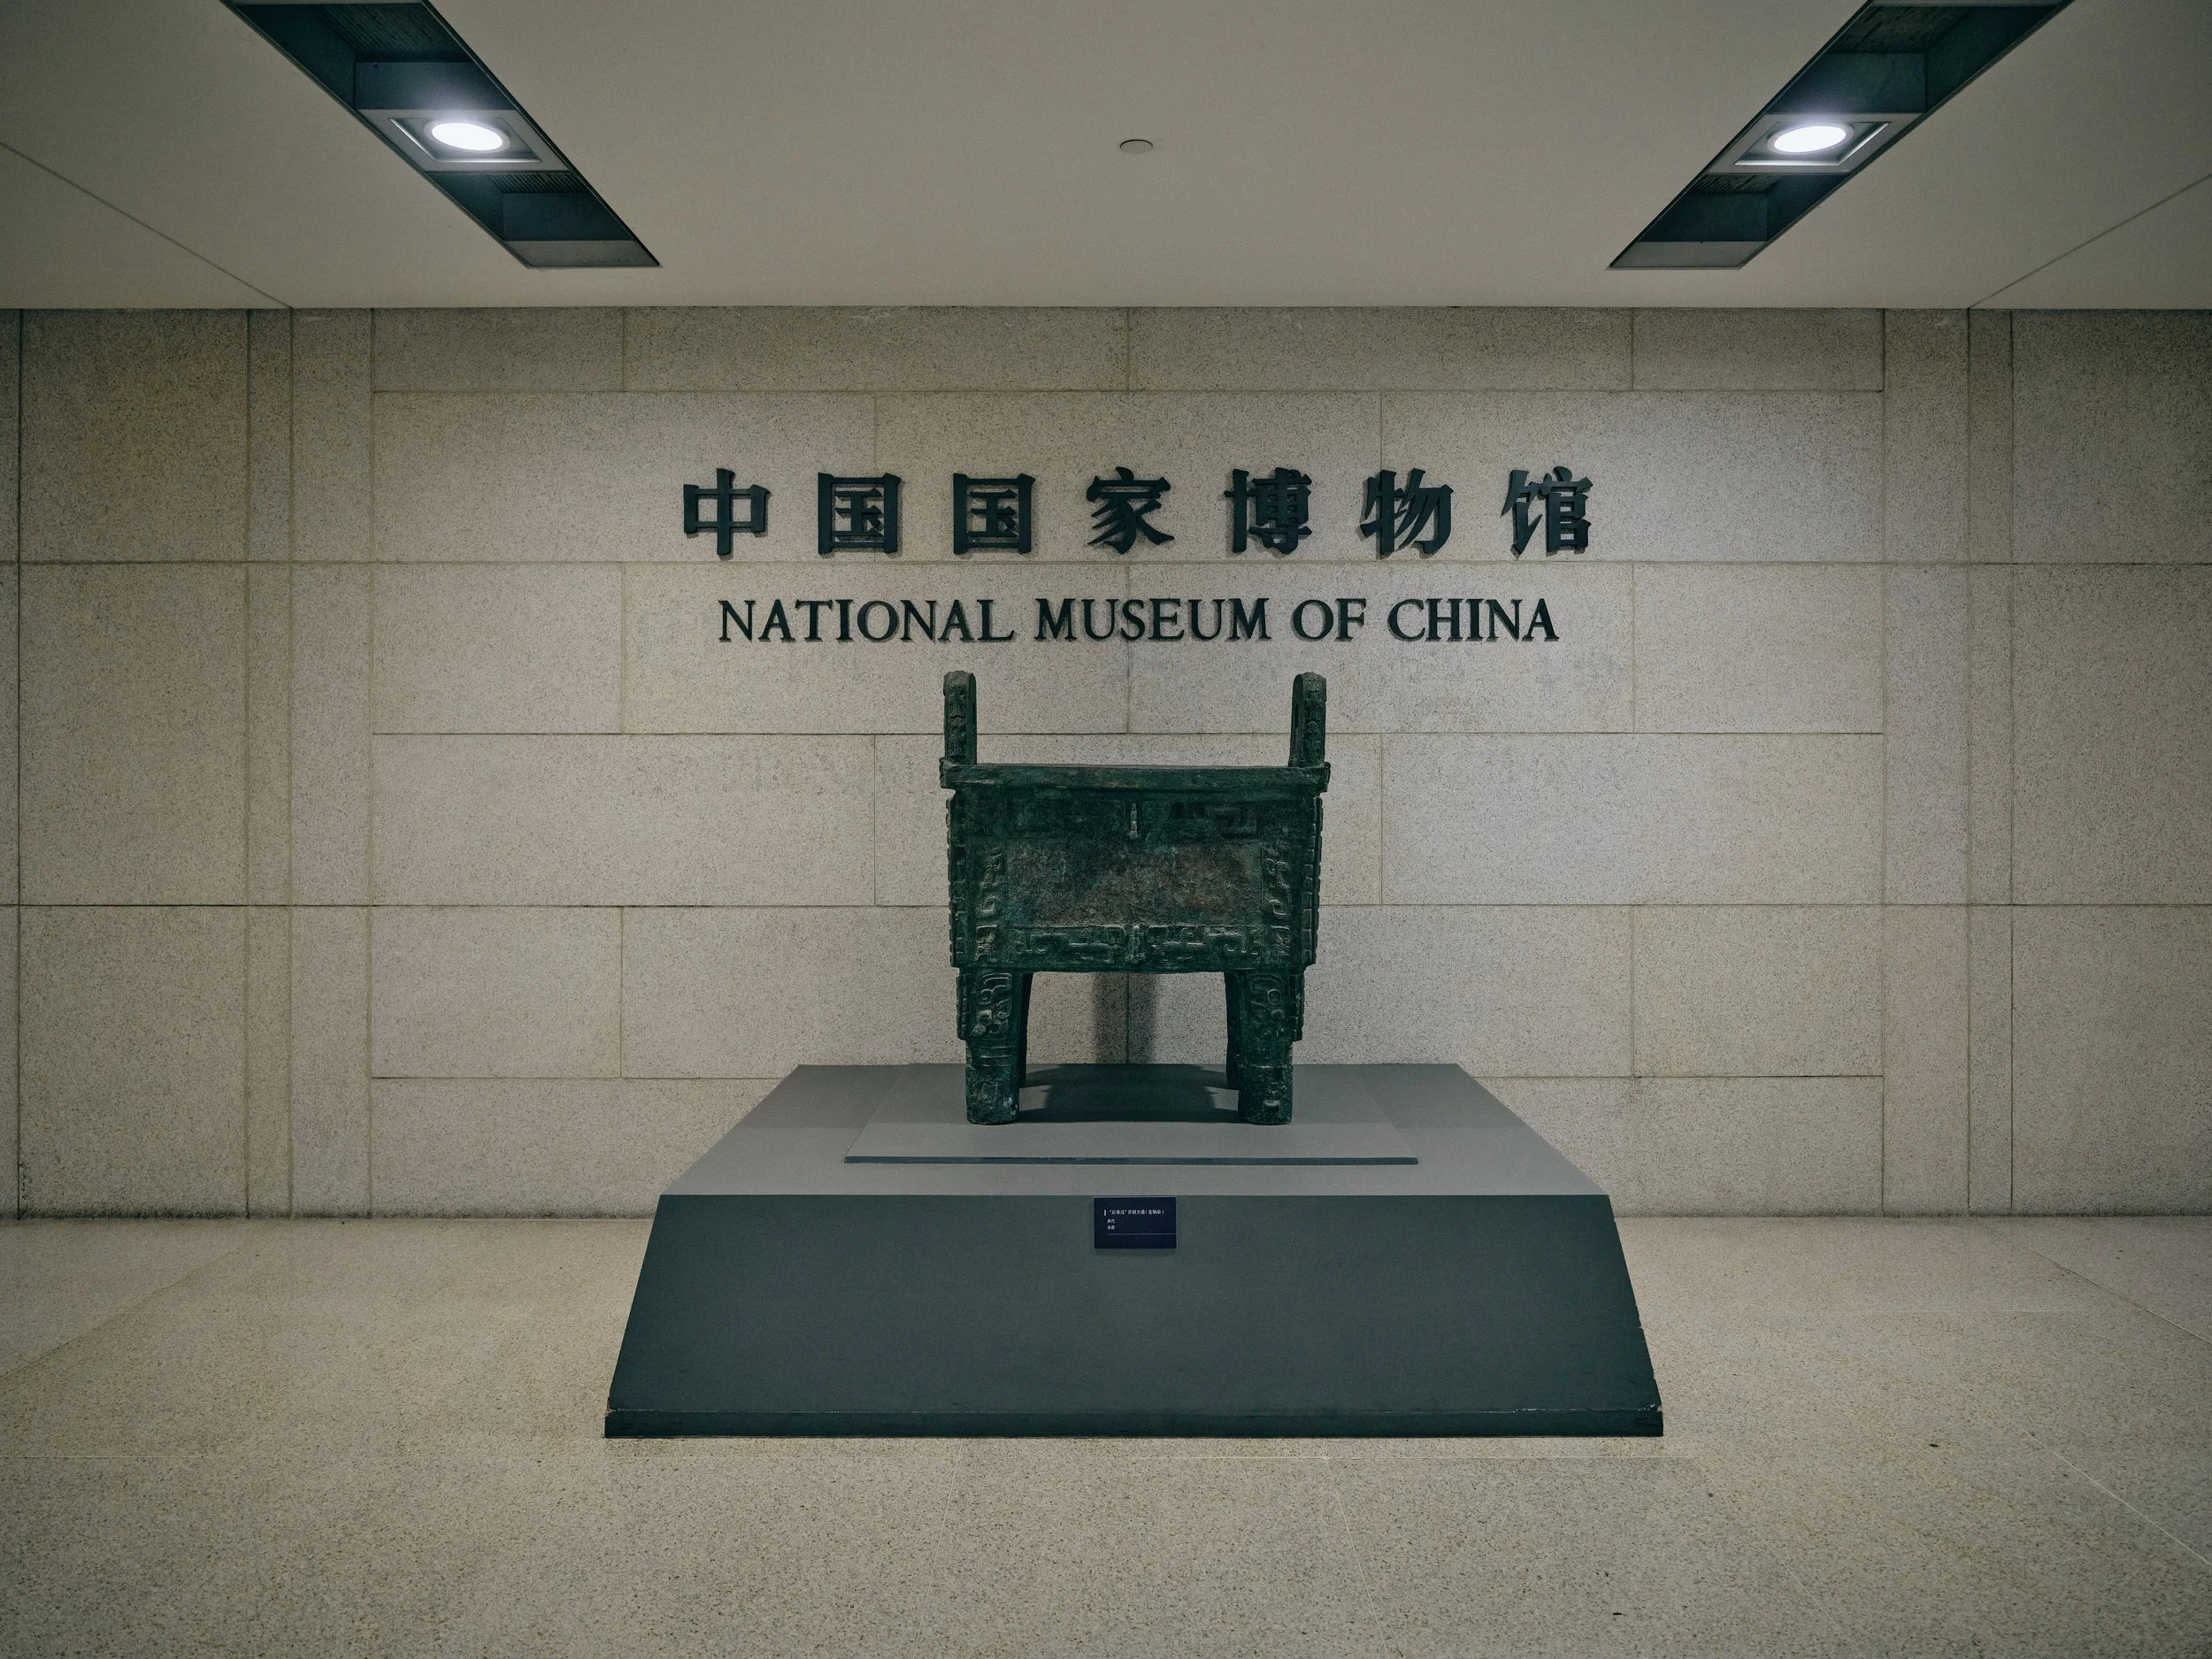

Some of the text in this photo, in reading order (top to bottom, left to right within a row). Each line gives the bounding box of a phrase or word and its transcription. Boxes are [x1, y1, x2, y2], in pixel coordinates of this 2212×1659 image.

[683, 465, 1594, 558] 中国国家博物馆
[718, 597, 1559, 642] NATIONAL MUSEUM OF CHINA
